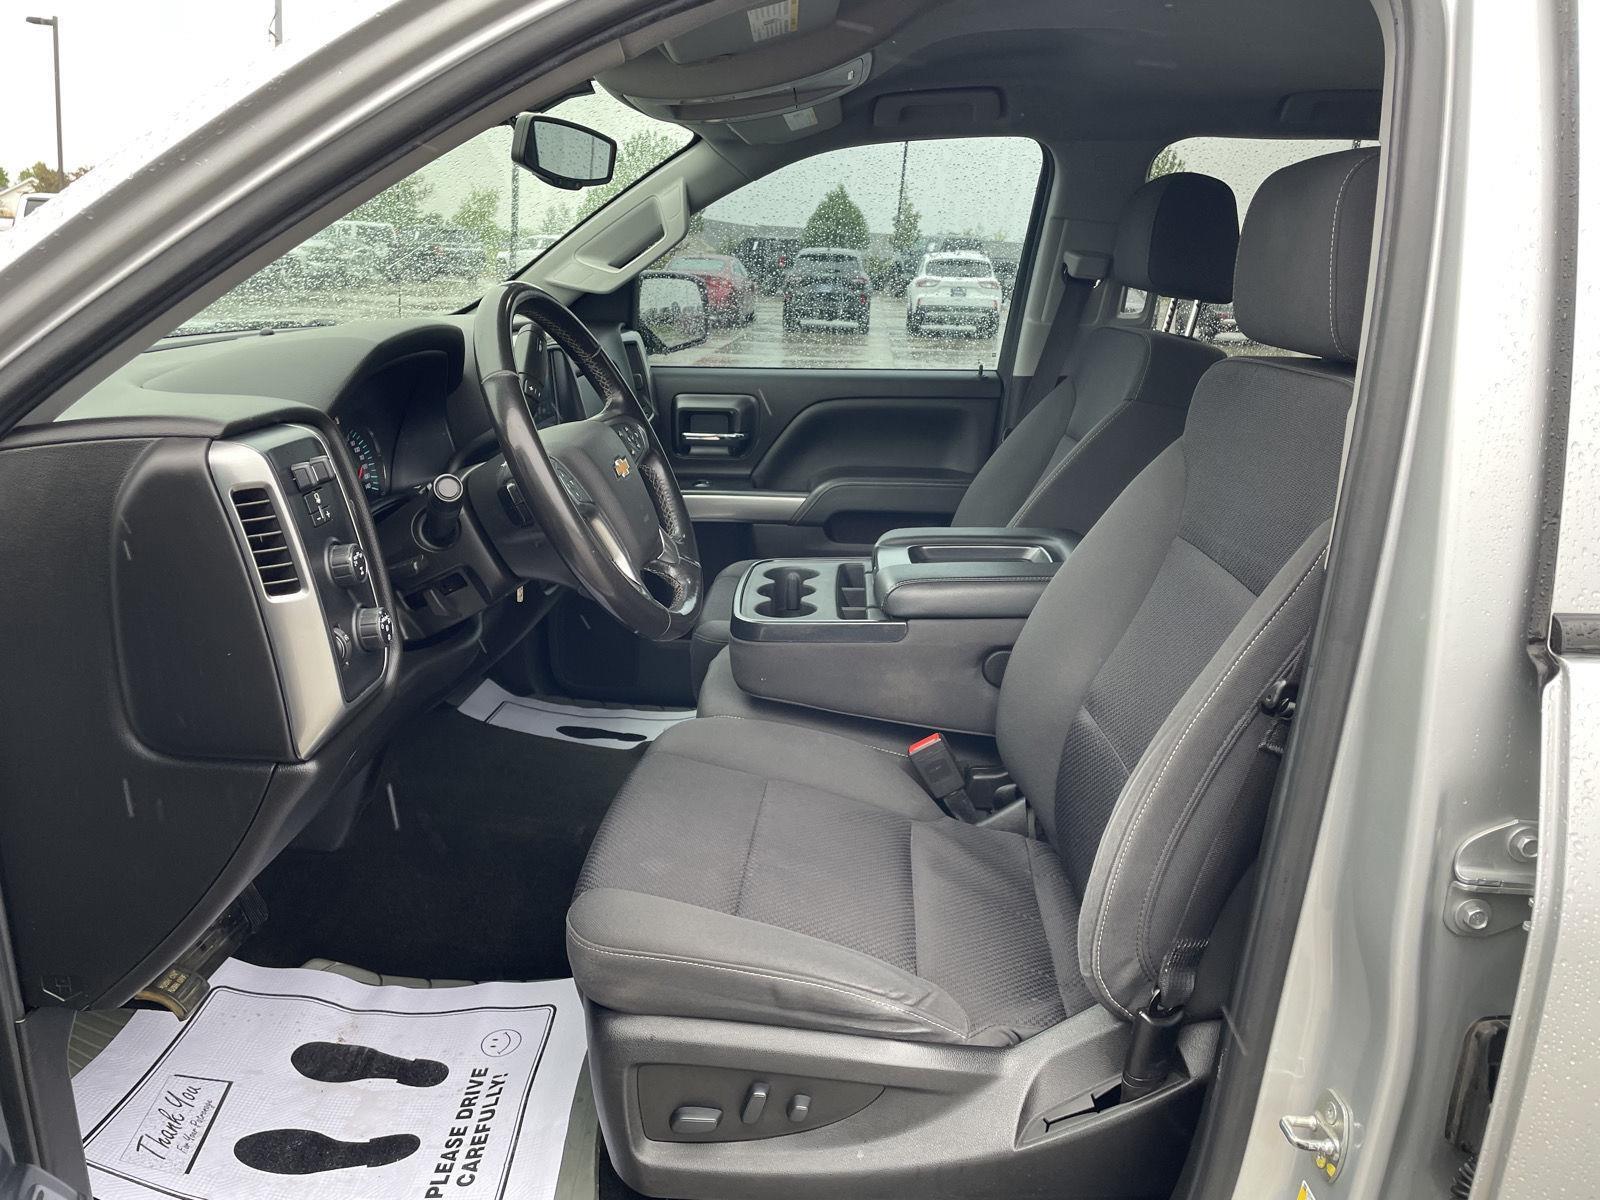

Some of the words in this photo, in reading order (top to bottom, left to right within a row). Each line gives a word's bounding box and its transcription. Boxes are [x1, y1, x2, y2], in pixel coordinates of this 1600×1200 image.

[136, 1108, 185, 1160] Thank
[164, 1086, 202, 1108] You
[177, 1142, 191, 1154] For
[425, 1126, 468, 1198] PLEASE
[455, 1067, 489, 1120] DRIVE
[456, 1073, 508, 1187] CAREFULLY!
